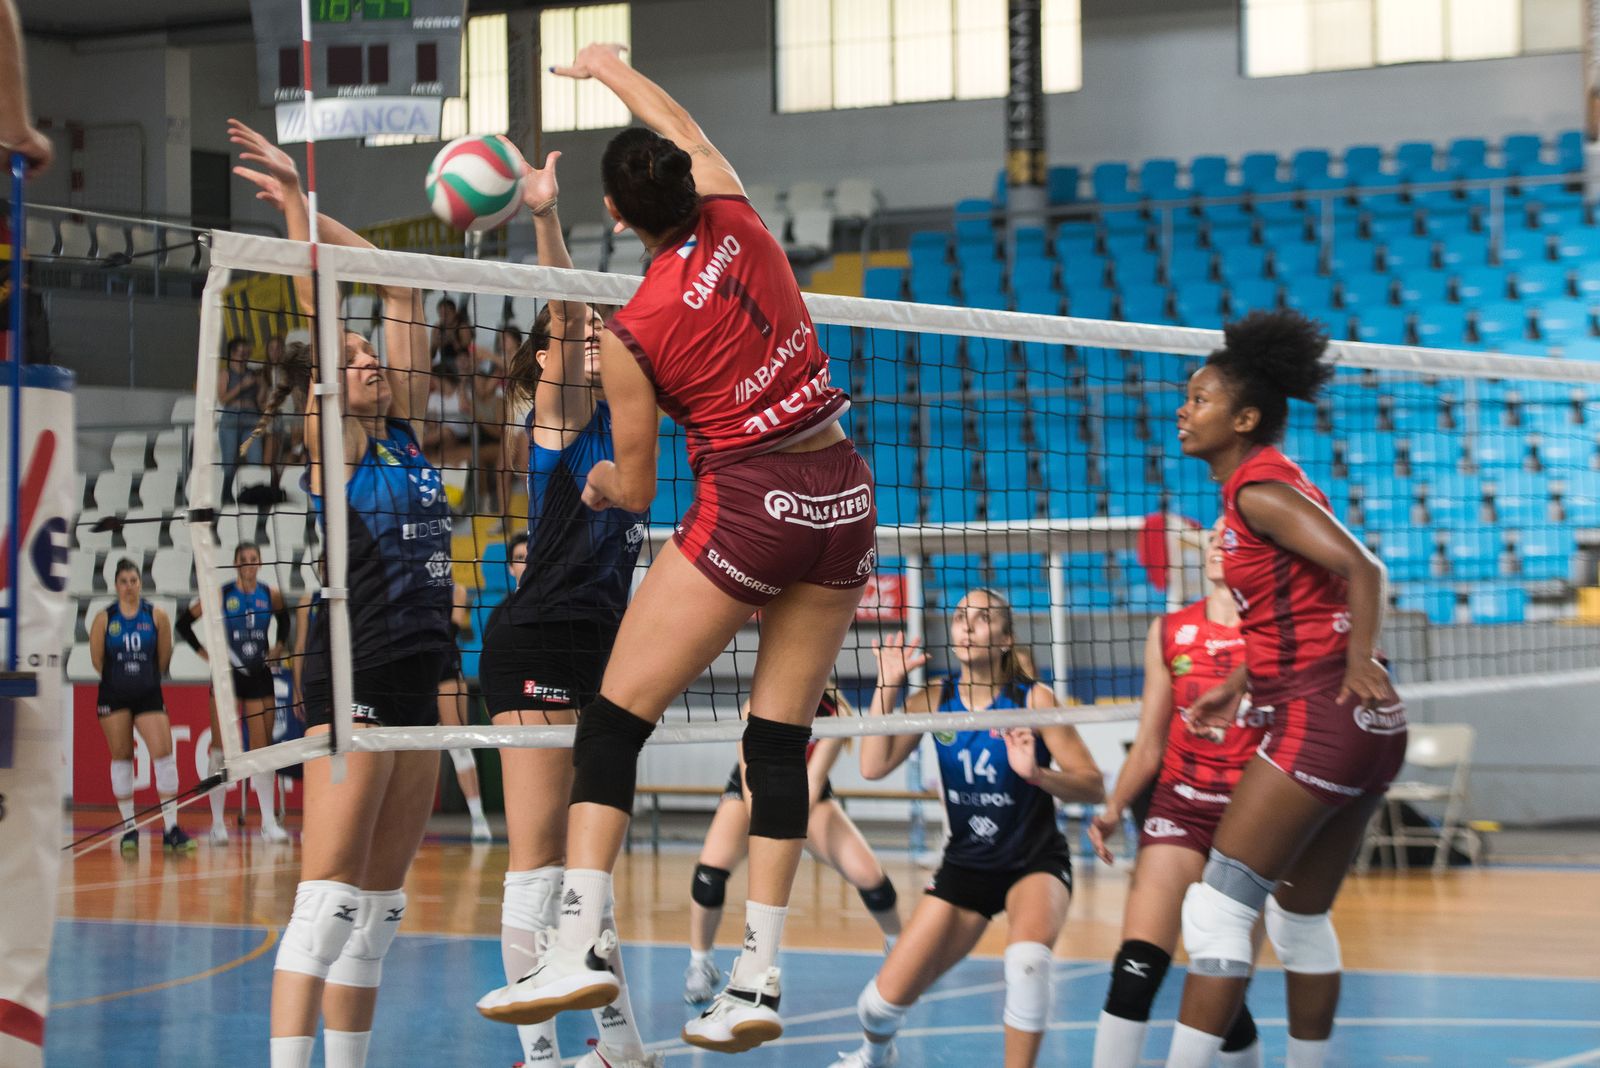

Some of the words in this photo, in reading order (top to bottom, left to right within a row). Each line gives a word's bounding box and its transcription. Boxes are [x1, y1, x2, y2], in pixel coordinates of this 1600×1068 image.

[683, 235, 741, 310] CAMINO
[122, 632, 141, 652] 10
[957, 748, 997, 785] 14
